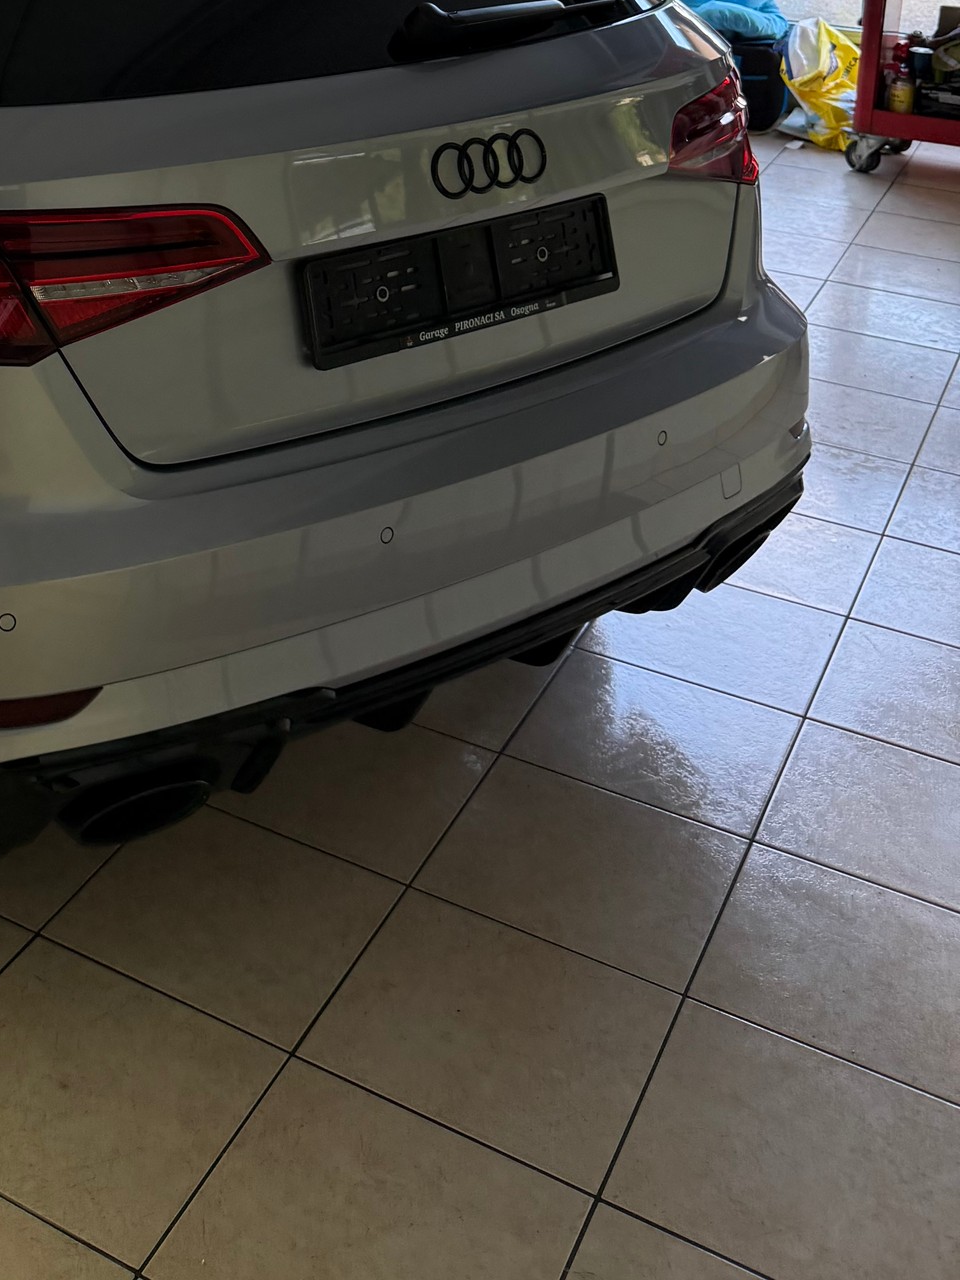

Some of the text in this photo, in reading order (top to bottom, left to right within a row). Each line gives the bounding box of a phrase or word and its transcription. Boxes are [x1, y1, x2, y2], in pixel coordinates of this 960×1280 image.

[419, 302, 539, 342] Garage PIRONACI SA Osogna
